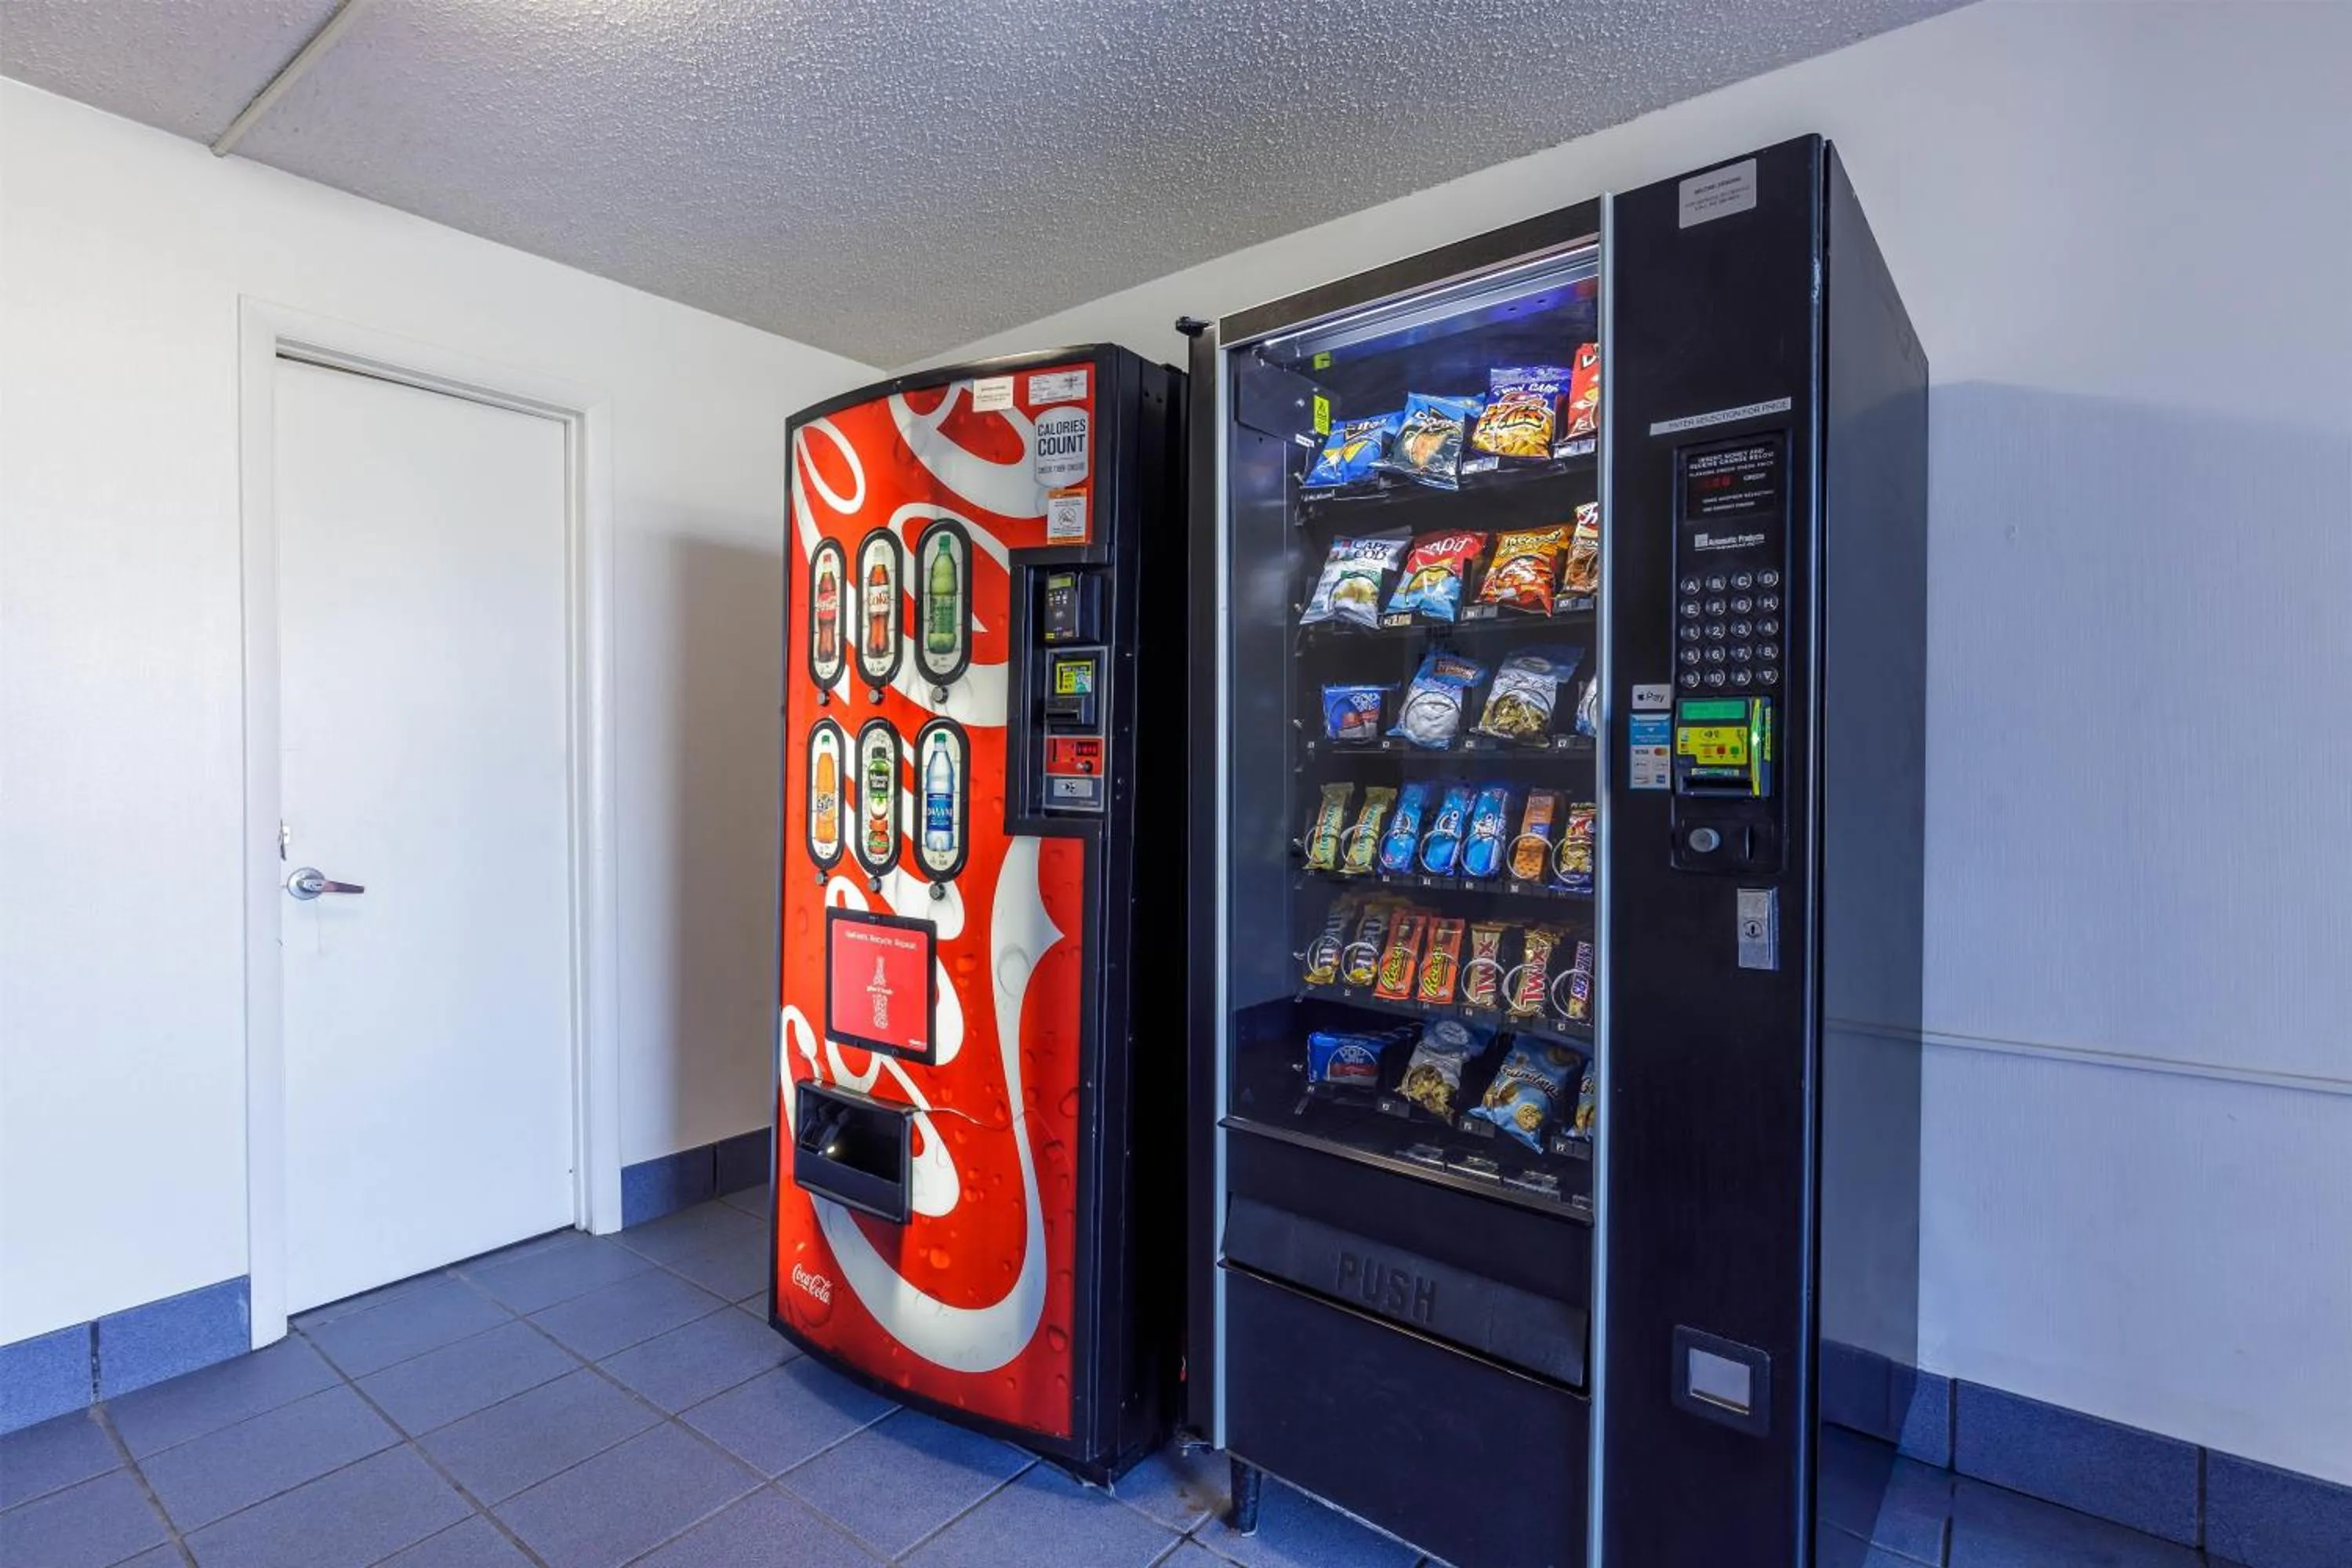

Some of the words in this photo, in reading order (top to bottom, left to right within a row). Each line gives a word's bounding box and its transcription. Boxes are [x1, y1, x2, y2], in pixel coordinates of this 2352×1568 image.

[1037, 417, 1086, 437] CALORIES
[1037, 434, 1086, 457] COUNT
[1352, 539, 1391, 550] CAPE
[1353, 549, 1387, 561] COD
[1687, 581, 1696, 590] A
[1711, 578, 1721, 588] B
[1737, 576, 1747, 586] C
[1764, 573, 1773, 583] D
[1687, 604, 1696, 614] E
[1764, 598, 1773, 608] H
[1712, 626, 1721, 636] 2
[1737, 624, 1746, 633] 3
[1711, 650, 1719, 659] 6
[1737, 648, 1745, 658] 7
[1764, 647, 1772, 657] 8
[1710, 673, 1721, 683] 10
[1646, 691, 1665, 703] Pay
[1475, 940, 1497, 997] TWIX
[1521, 948, 1547, 1007] TWIX
[792, 1262, 832, 1305] Coca-Cola
[1335, 1252, 1436, 1324] PUSH
